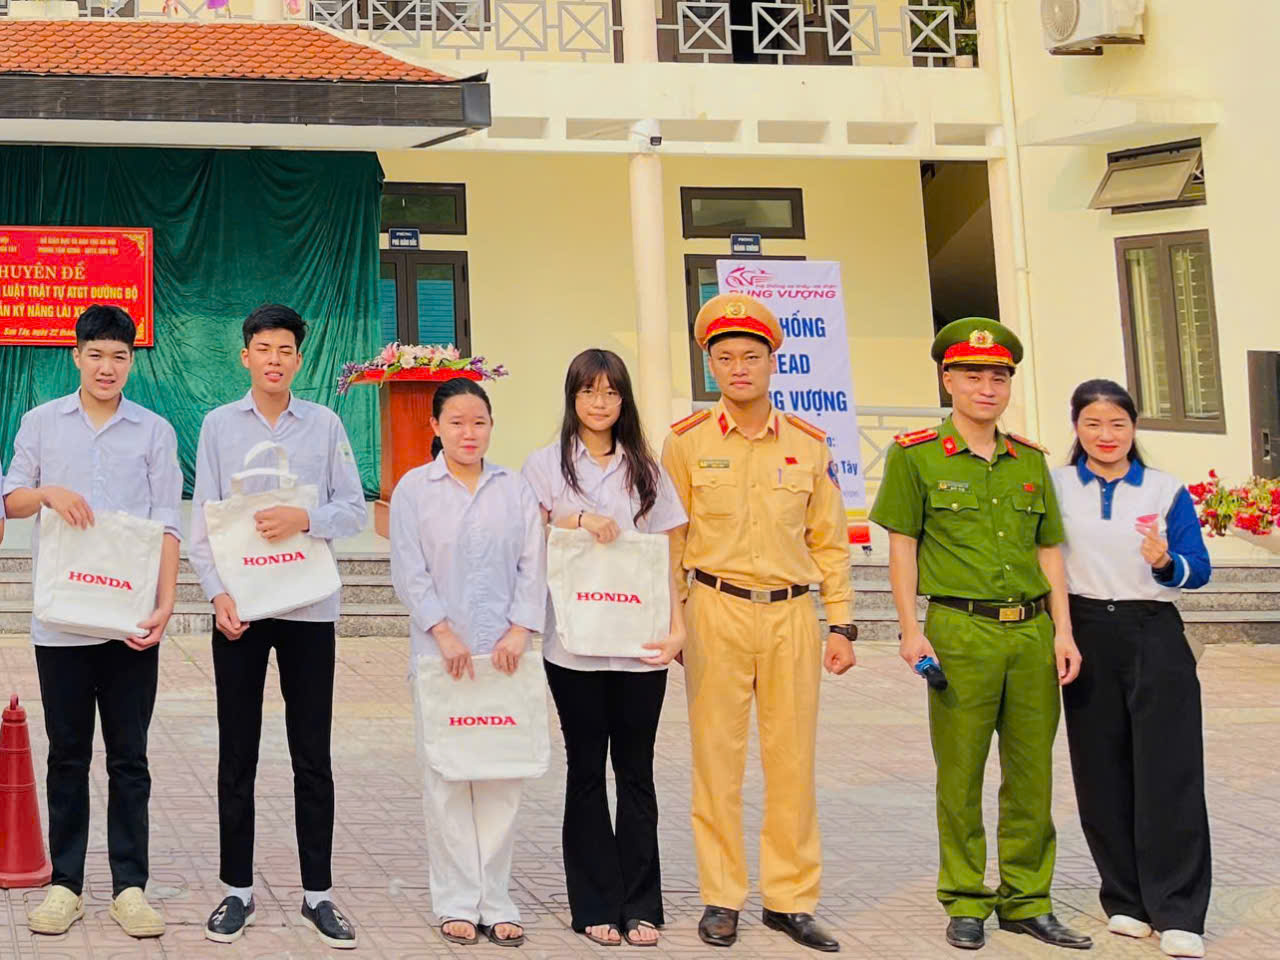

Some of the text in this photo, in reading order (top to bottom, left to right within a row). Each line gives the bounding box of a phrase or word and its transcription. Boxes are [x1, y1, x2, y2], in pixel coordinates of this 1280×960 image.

[61, 260, 86, 280] ĐỀ
[3, 283, 25, 300] LUẬT
[28, 282, 50, 300] TRẬT
[53, 284, 65, 300] TỰ
[67, 286, 88, 298] ATGT
[125, 284, 138, 302] BỘ
[777, 289, 836, 300] VƯỢNG
[28, 303, 54, 317] NĂNG
[56, 303, 71, 318] LÁI
[779, 310, 826, 338] HỐNG
[60, 328, 77, 337] thán
[776, 353, 810, 374] EAD
[789, 388, 848, 417] VƯỢNG
[841, 460, 858, 476] Tây
[243, 551, 305, 566] HONDA
[68, 571, 133, 591] HONDA
[576, 591, 642, 605] HONDA
[449, 715, 517, 727] HONDA
